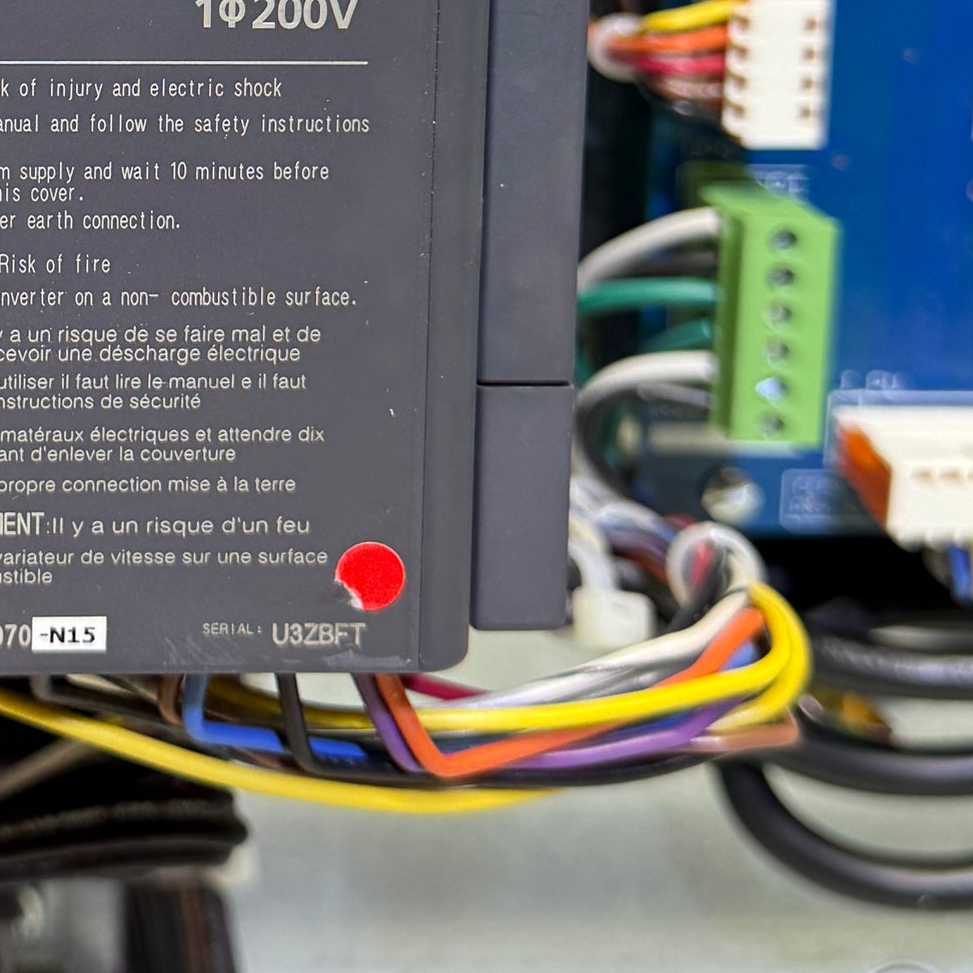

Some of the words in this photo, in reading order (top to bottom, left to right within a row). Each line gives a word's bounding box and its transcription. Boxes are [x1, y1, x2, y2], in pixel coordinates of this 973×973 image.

[19, 77, 37, 97] of
[50, 78, 103, 101] injury
[112, 78, 141, 97] and
[150, 78, 224, 97] electric
[234, 77, 282, 97] shock
[50, 114, 79, 133] and
[90, 113, 147, 133] follow
[158, 113, 184, 133] the
[194, 113, 250, 137] safety
[261, 114, 370, 133] instructions
[19, 161, 75, 184] supply
[83, 161, 112, 180] and
[121, 161, 160, 181] wait
[170, 161, 187, 180] 10
[195, 161, 264, 181] minutes
[273, 160, 329, 180] before
[30, 187, 84, 202] cover.
[27, 209, 73, 230] earth
[82, 209, 180, 230] connection.
[46, 253, 63, 274] of
[75, 253, 111, 274] fire
[74, 291, 94, 307] on
[101, 291, 112, 306] a
[120, 291, 159, 306] non-
[171, 286, 276, 307] combustible
[285, 286, 356, 307] surface.
[9, 329, 21, 343] a
[27, 328, 51, 348] un
[58, 325, 118, 347] risque
[124, 325, 149, 343] de
[155, 328, 178, 343] se
[183, 324, 226, 348] faire
[231, 324, 266, 343] mal
[272, 326, 291, 343] et
[296, 325, 321, 343] de
[58, 347, 93, 362] une
[99, 344, 201, 366] déscharge
[207, 343, 301, 365] électrique
[61, 373, 70, 390] il
[75, 373, 109, 390] faut
[115, 373, 142, 390] lire
[147, 373, 166, 390] le
[168, 373, 235, 390] manuel
[241, 376, 252, 390] e
[258, 372, 267, 389] il
[272, 372, 306, 390] faut
[100, 393, 124, 409] de
[129, 392, 201, 410] sécurité
[0, 426, 84, 443] matéraux
[89, 426, 190, 446] électriques
[195, 427, 212, 443] et
[217, 426, 292, 443] attendre
[298, 426, 325, 442] dix
[30, 445, 113, 462] d'enlever
[119, 445, 135, 462] la
[140, 446, 236, 462] couverture
[61, 477, 162, 493] connection
[168, 475, 211, 492] mise
[216, 476, 228, 492] à
[233, 475, 250, 492] la
[254, 477, 296, 492] terre
[71, 520, 84, 538] y
[91, 520, 105, 535] a
[112, 520, 138, 534] un
[146, 516, 214, 538] risque
[221, 516, 269, 534] d'un
[276, 515, 310, 534] feu
[80, 549, 105, 565] de
[110, 550, 176, 565] vitesse
[181, 551, 211, 565] sur
[217, 551, 252, 564] une
[257, 547, 328, 565] surface
[40, 627, 95, 644] -N15
[202, 622, 262, 636] SERIAL:
[272, 622, 367, 646] U3ZBFT
